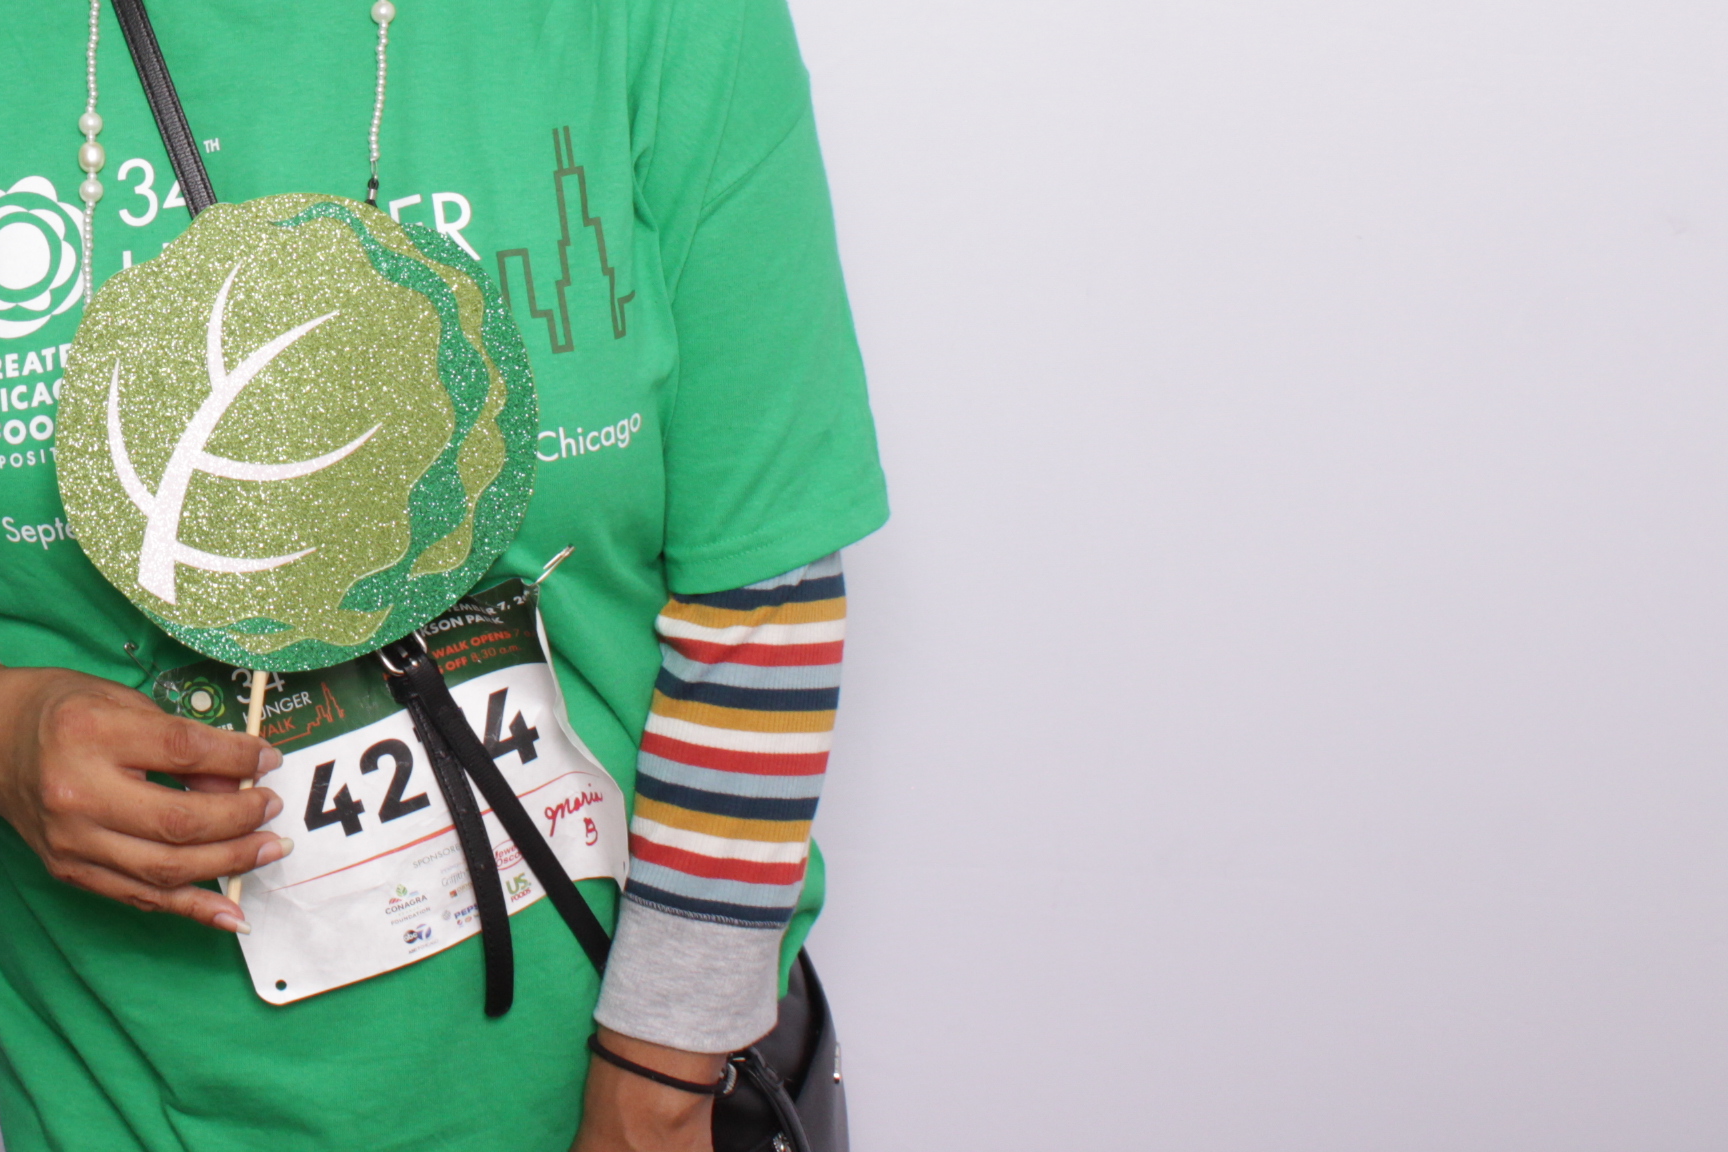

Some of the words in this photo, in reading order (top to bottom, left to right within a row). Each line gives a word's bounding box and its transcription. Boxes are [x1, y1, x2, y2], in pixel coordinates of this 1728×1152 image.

[2, 516, 76, 550] Septe
[536, 412, 642, 462] Chicago
[421, 615, 464, 637] KSON
[432, 641, 469, 659] WALK
[470, 630, 512, 648] OPENS
[445, 656, 468, 671] OFF
[304, 687, 540, 837] 424
[385, 894, 428, 915] CONAGRA
[510, 888, 531, 902] FOODS
[390, 907, 431, 926] FOUNDATION
